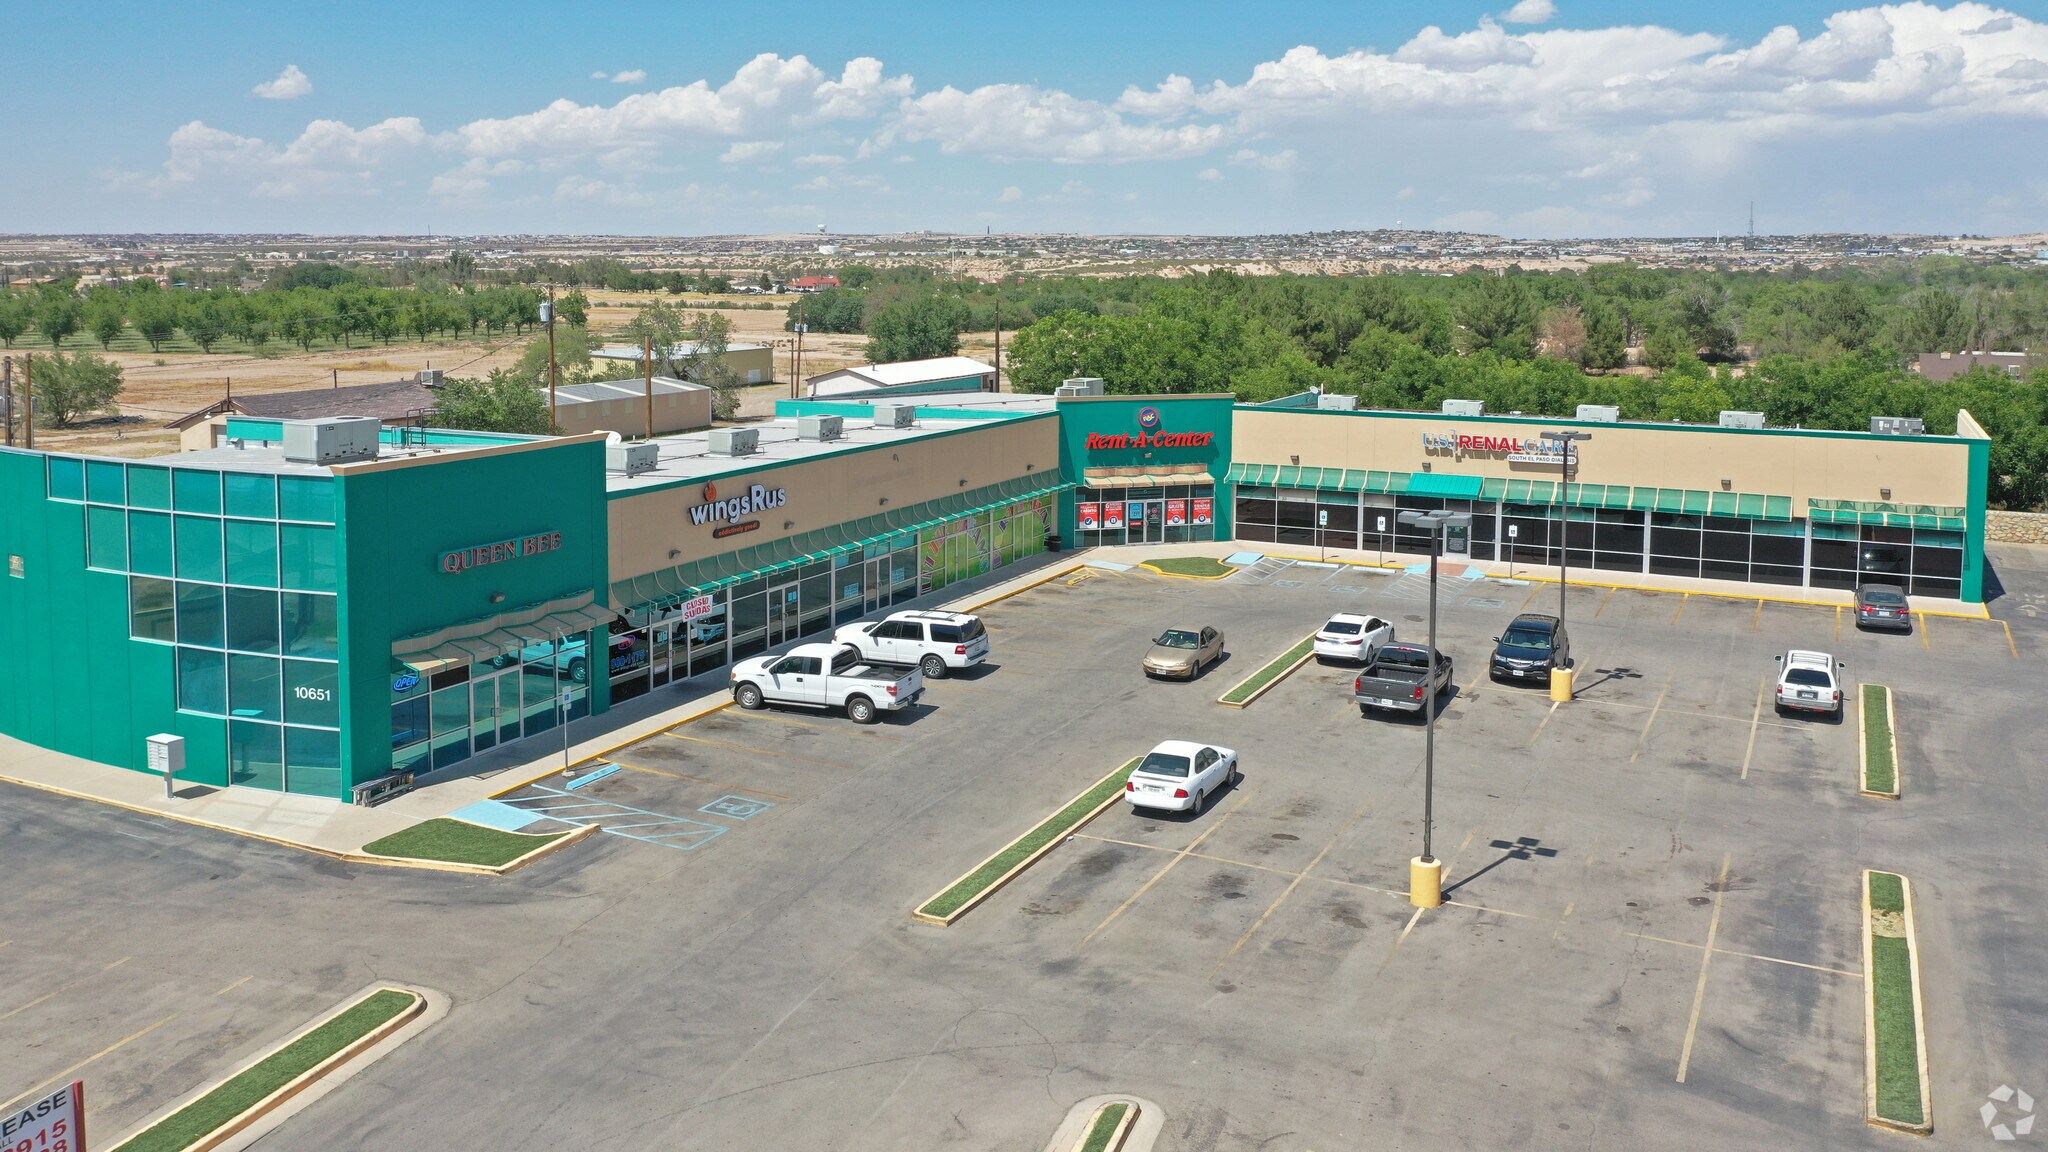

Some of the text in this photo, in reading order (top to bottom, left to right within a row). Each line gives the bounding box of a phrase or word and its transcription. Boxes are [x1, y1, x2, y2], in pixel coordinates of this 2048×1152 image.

[1459, 434, 1522, 452] RENAL
[1523, 437, 1577, 456] CARE
[443, 531, 562, 575] QUEEN BEE
[294, 686, 331, 702] 10651
[395, 676, 419, 688] OPEN
[0, 1090, 67, 1138] EASE
[4, 1118, 67, 1152] 915
